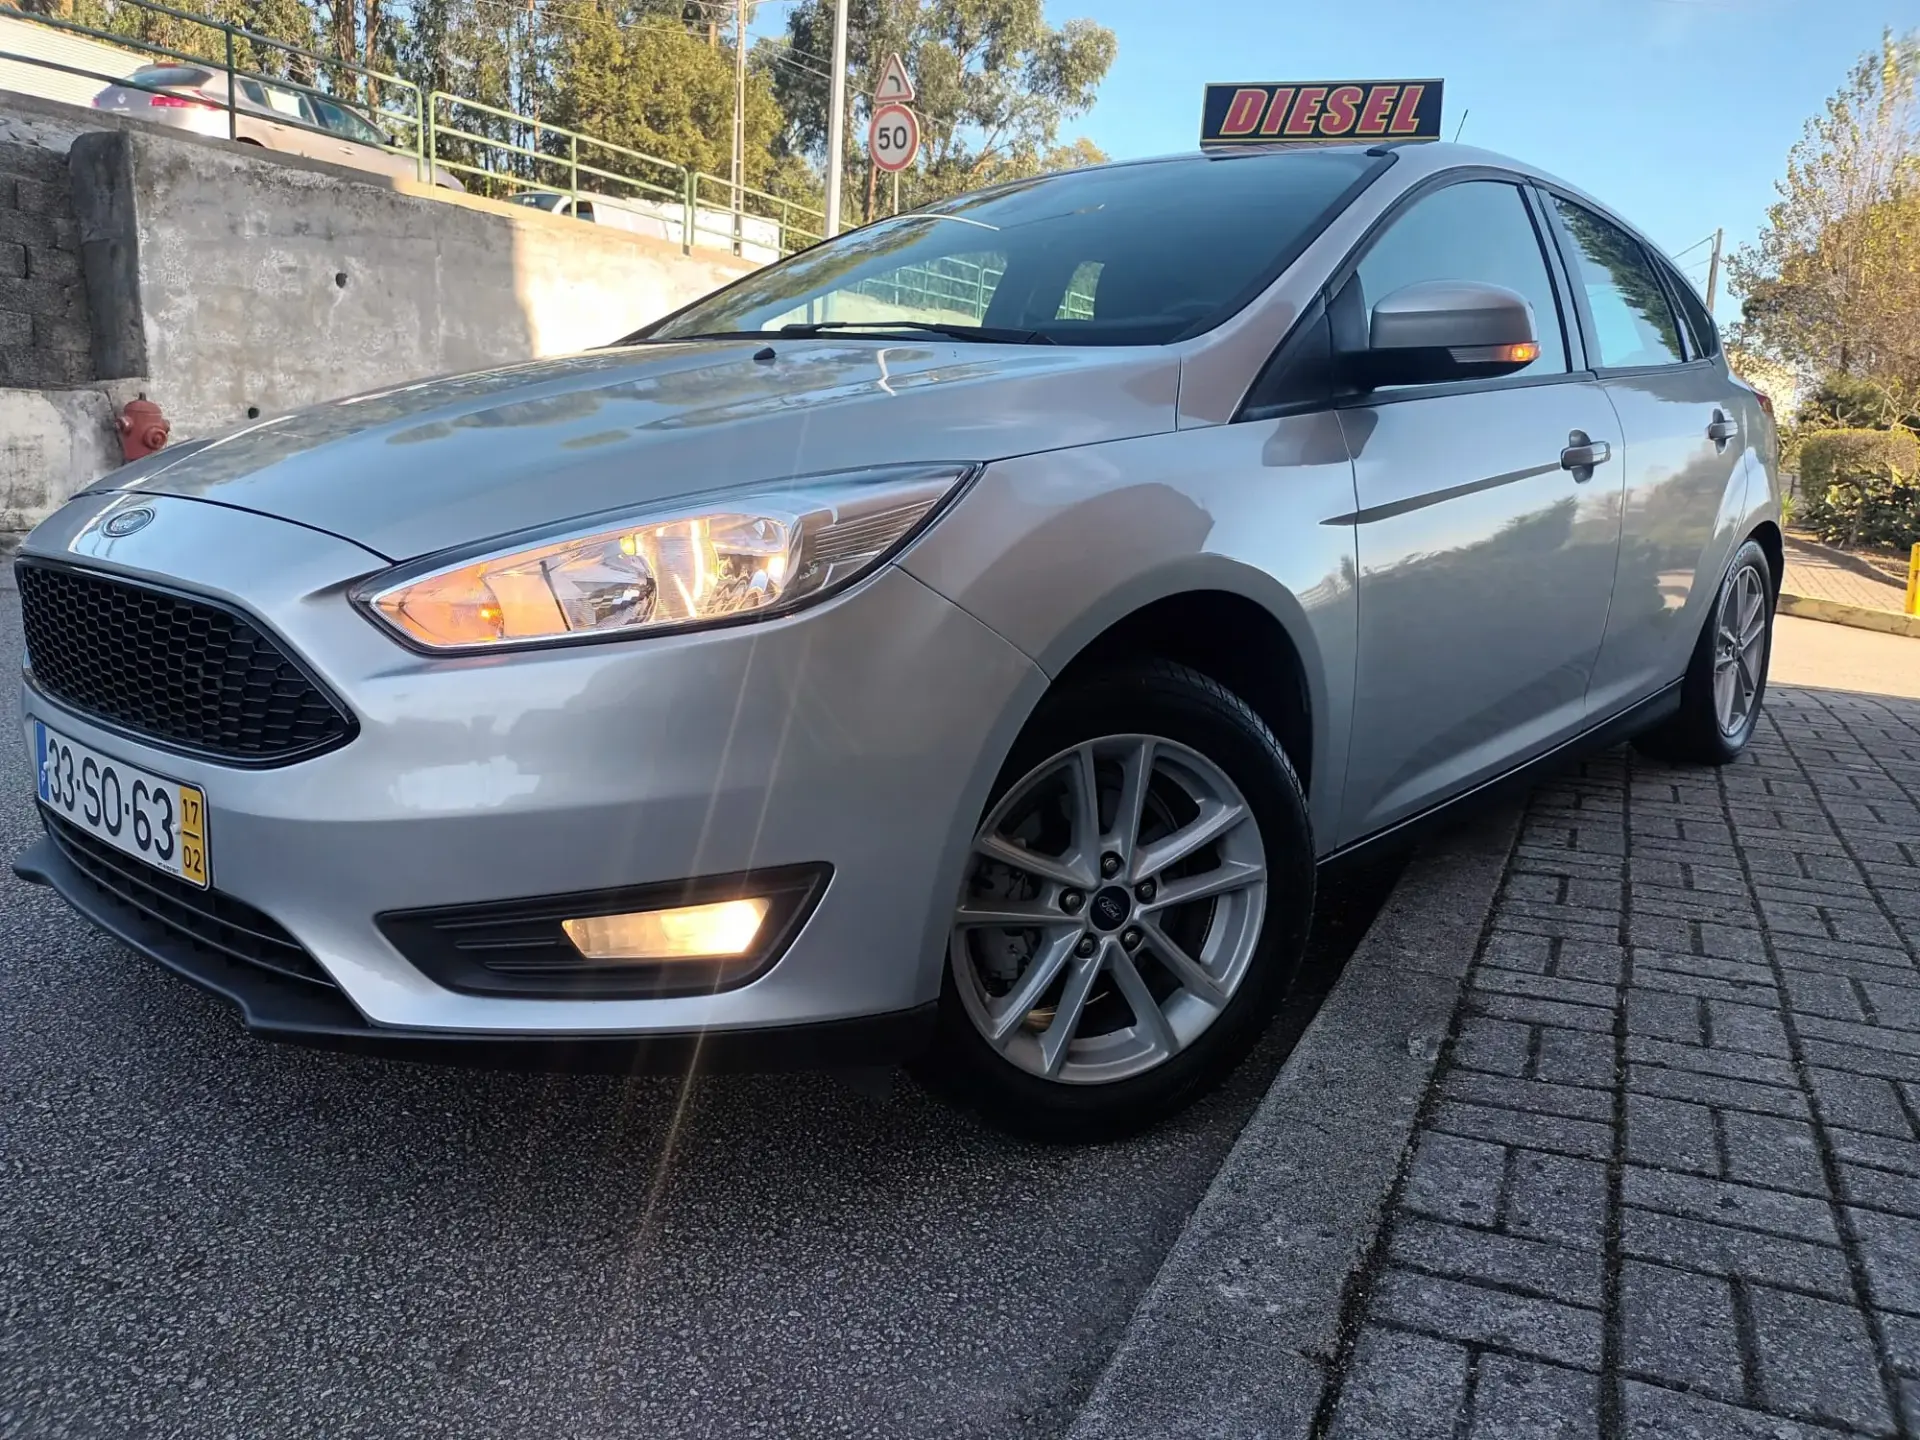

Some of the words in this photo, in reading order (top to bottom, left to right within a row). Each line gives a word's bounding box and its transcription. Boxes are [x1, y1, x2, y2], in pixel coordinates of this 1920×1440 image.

[1219, 85, 1425, 135] DIESEL
[878, 126, 907, 150] 50
[183, 798, 199, 825] 17
[183, 845, 201, 873] 02
